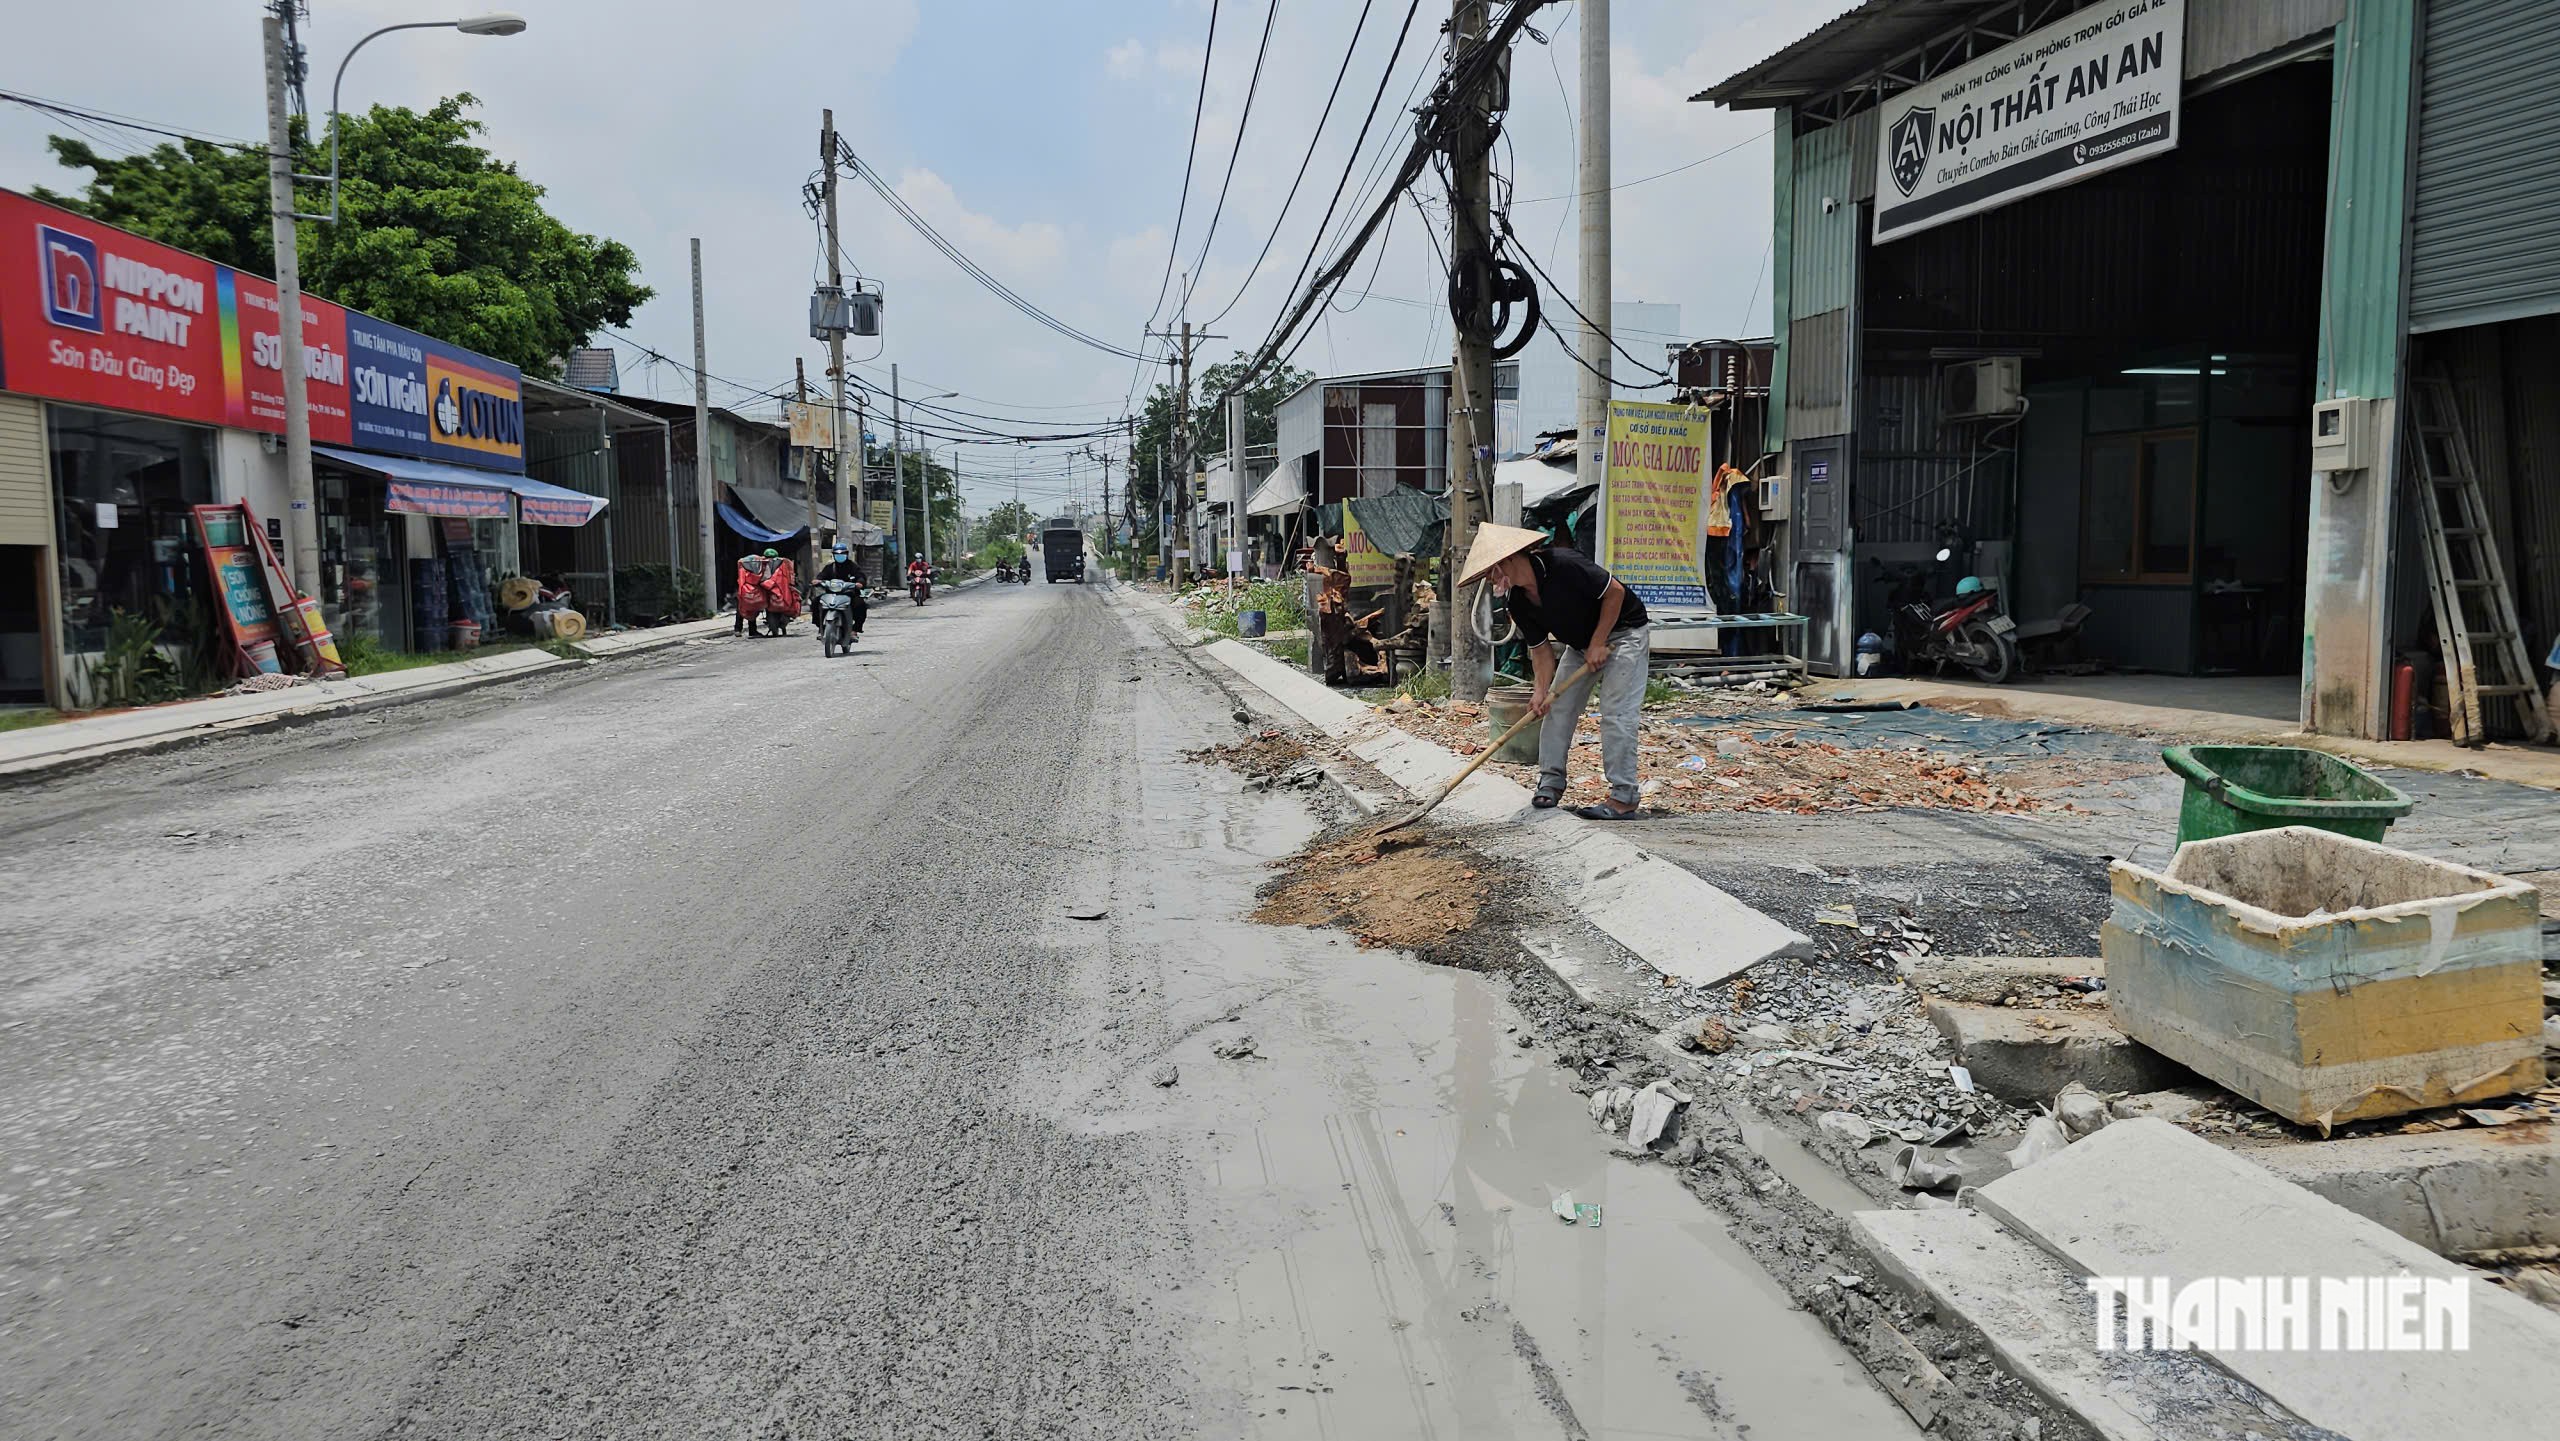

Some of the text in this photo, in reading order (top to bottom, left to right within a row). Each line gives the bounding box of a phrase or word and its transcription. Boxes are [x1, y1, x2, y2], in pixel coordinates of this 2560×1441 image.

[1968, 76, 1983, 91] THI
[1984, 64, 2011, 83] CÔNG
[2035, 37, 2071, 61] PHÒNG
[2074, 23, 2103, 42] TRỌN
[2106, 11, 2125, 30] GÓI
[1938, 31, 2164, 156] NỘI THẤT AN AN
[1937, 90, 2162, 185] Chuyên Combo Bàn Ghế Gaming, Công Thái Học
[2088, 124, 2162, 157] 0932556803 (Zalo)
[104, 253, 204, 314] NIPPON
[115, 298, 192, 347] PAINT
[128, 357, 164, 390] Cũng
[168, 365, 196, 396] Đẹp
[355, 366, 428, 415] SƠN NGÂN
[457, 386, 520, 445] JOTUN
[1613, 434, 1700, 474] MỘC GIA LONG
